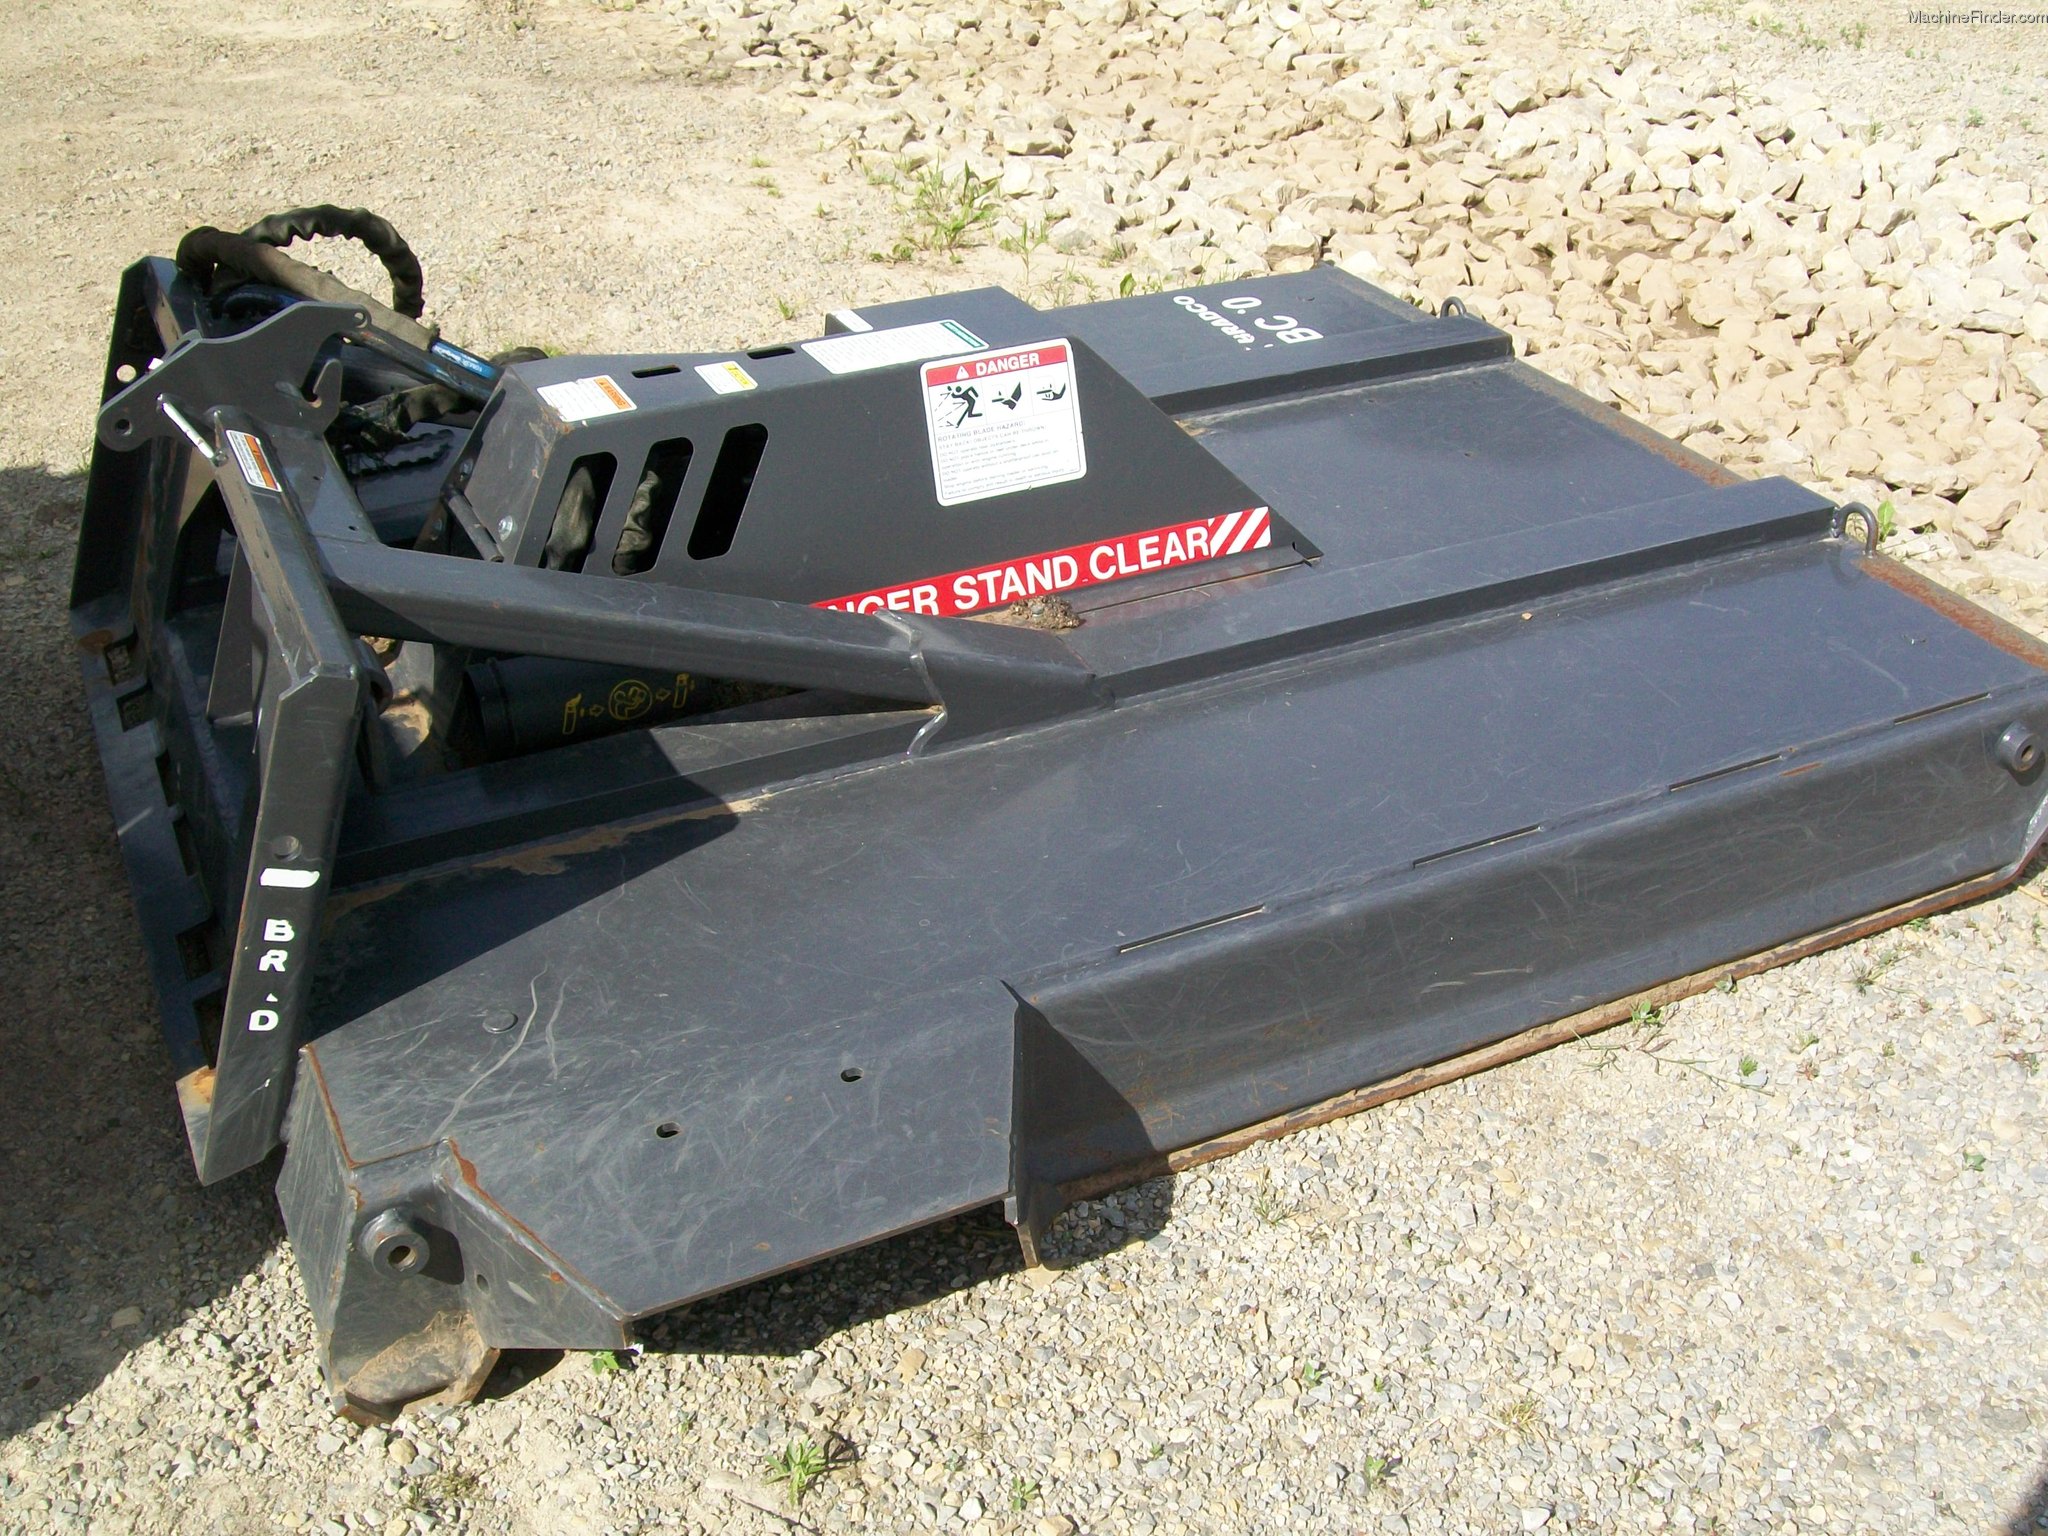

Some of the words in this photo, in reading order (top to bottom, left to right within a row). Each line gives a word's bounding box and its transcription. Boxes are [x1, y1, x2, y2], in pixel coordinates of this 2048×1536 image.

[975, 352, 1040, 376] DANGER
[953, 556, 1079, 609] STAND
[1088, 526, 1210, 580] CLEAR
[248, 918, 295, 1032] BRD
